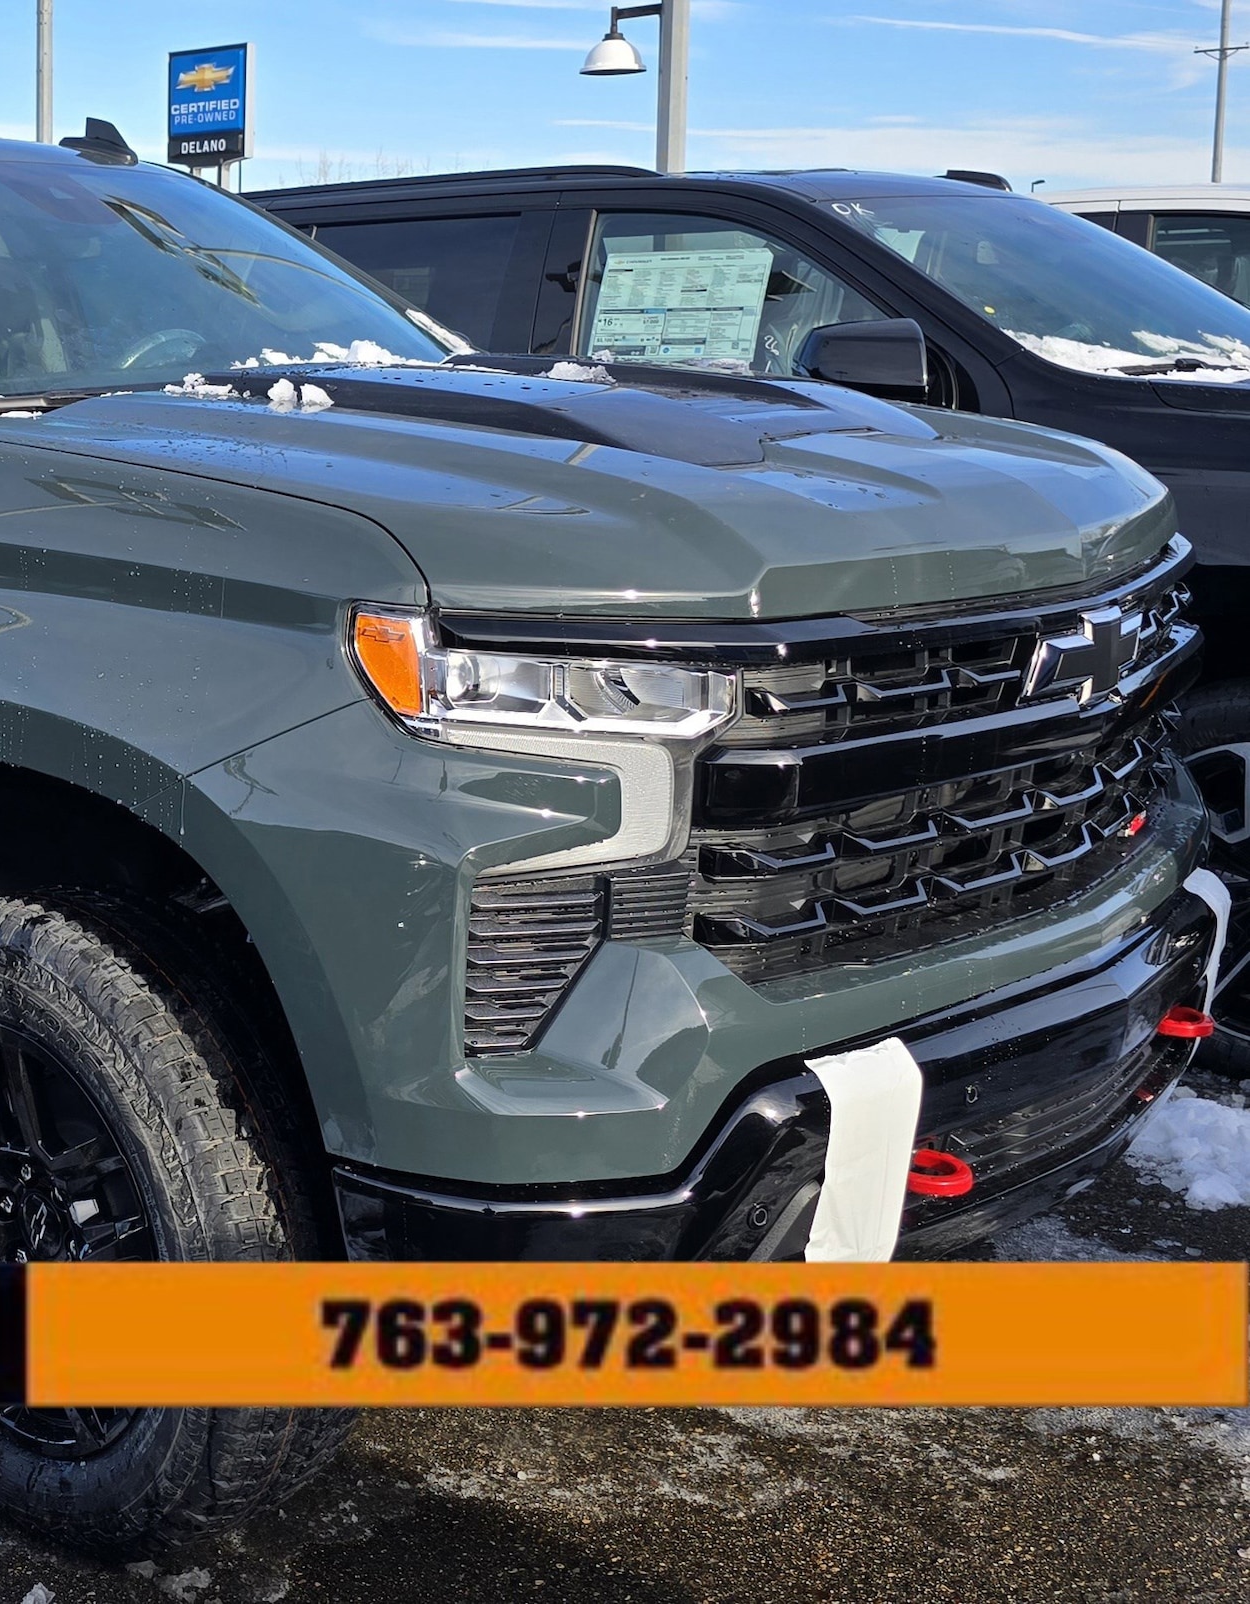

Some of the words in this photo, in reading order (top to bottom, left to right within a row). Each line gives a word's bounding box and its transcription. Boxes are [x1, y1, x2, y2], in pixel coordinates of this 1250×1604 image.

[171, 98, 240, 115] CERTIFIED
[174, 110, 236, 125] PRE-OWNED
[181, 139, 227, 154] DELANO
